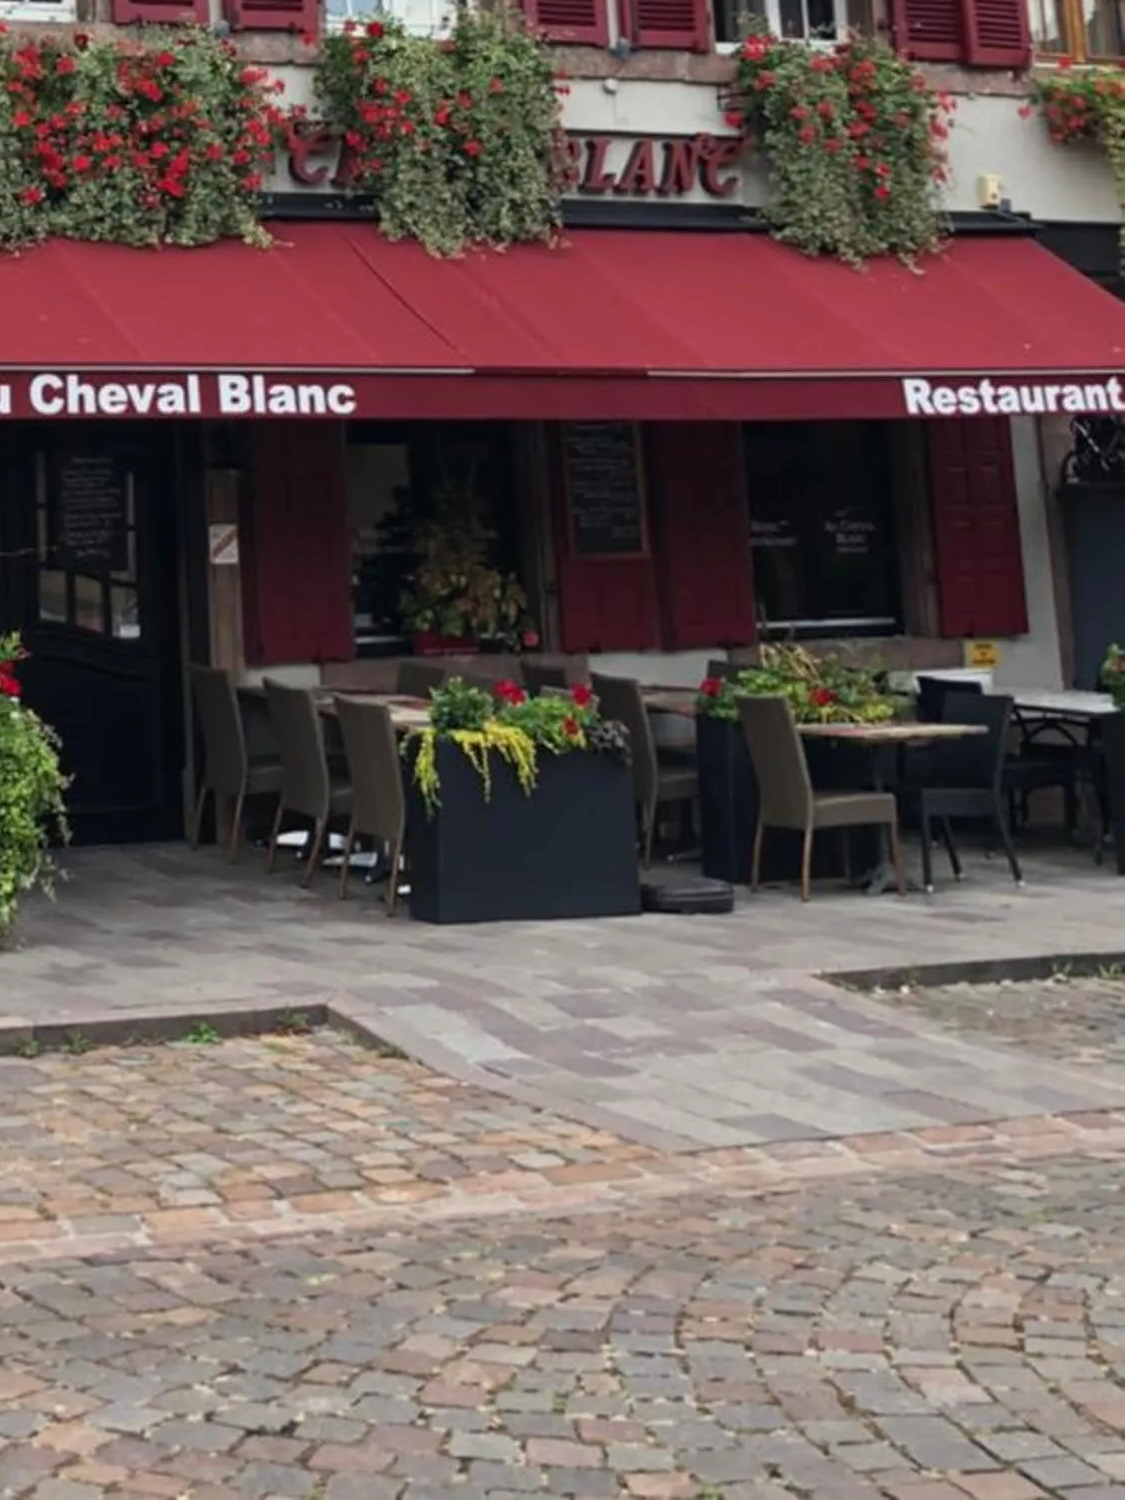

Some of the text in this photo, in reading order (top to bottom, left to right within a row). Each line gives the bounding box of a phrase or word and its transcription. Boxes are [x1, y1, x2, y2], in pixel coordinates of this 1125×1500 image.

[29, 374, 202, 415] Cheval
[217, 374, 357, 415] Blanc
[902, 377, 1125, 415] Restaurant
